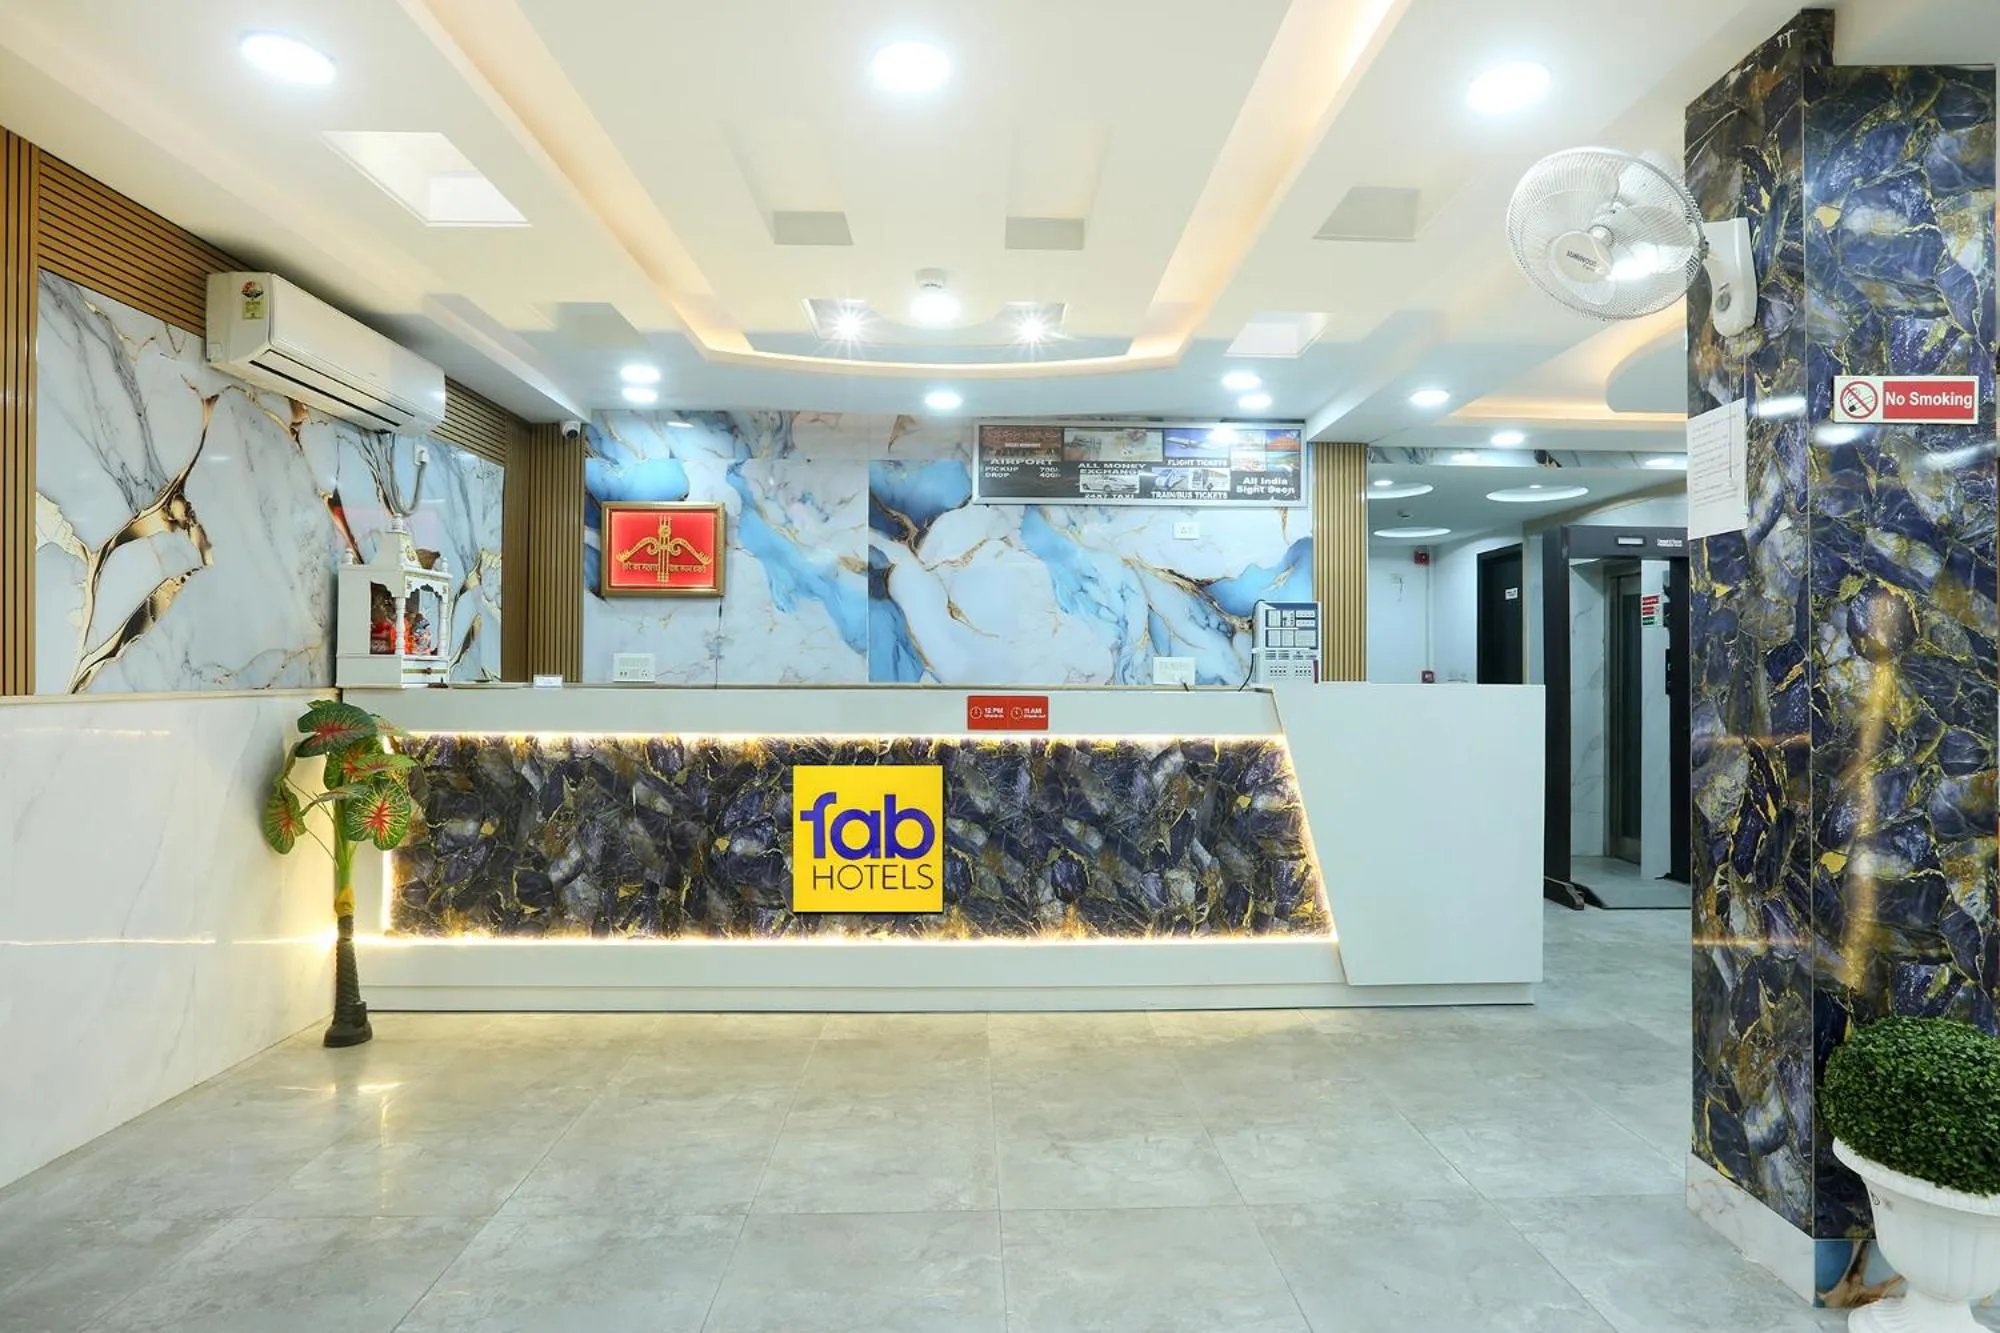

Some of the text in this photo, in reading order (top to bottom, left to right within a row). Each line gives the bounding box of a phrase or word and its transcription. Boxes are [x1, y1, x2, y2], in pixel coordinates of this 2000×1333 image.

[1885, 391, 1973, 408] No Smoking
[1242, 476, 1288, 485] All India
[1195, 491, 1228, 500] TICKETS
[800, 791, 935, 860] fab
[812, 863, 934, 891] HOTELS
